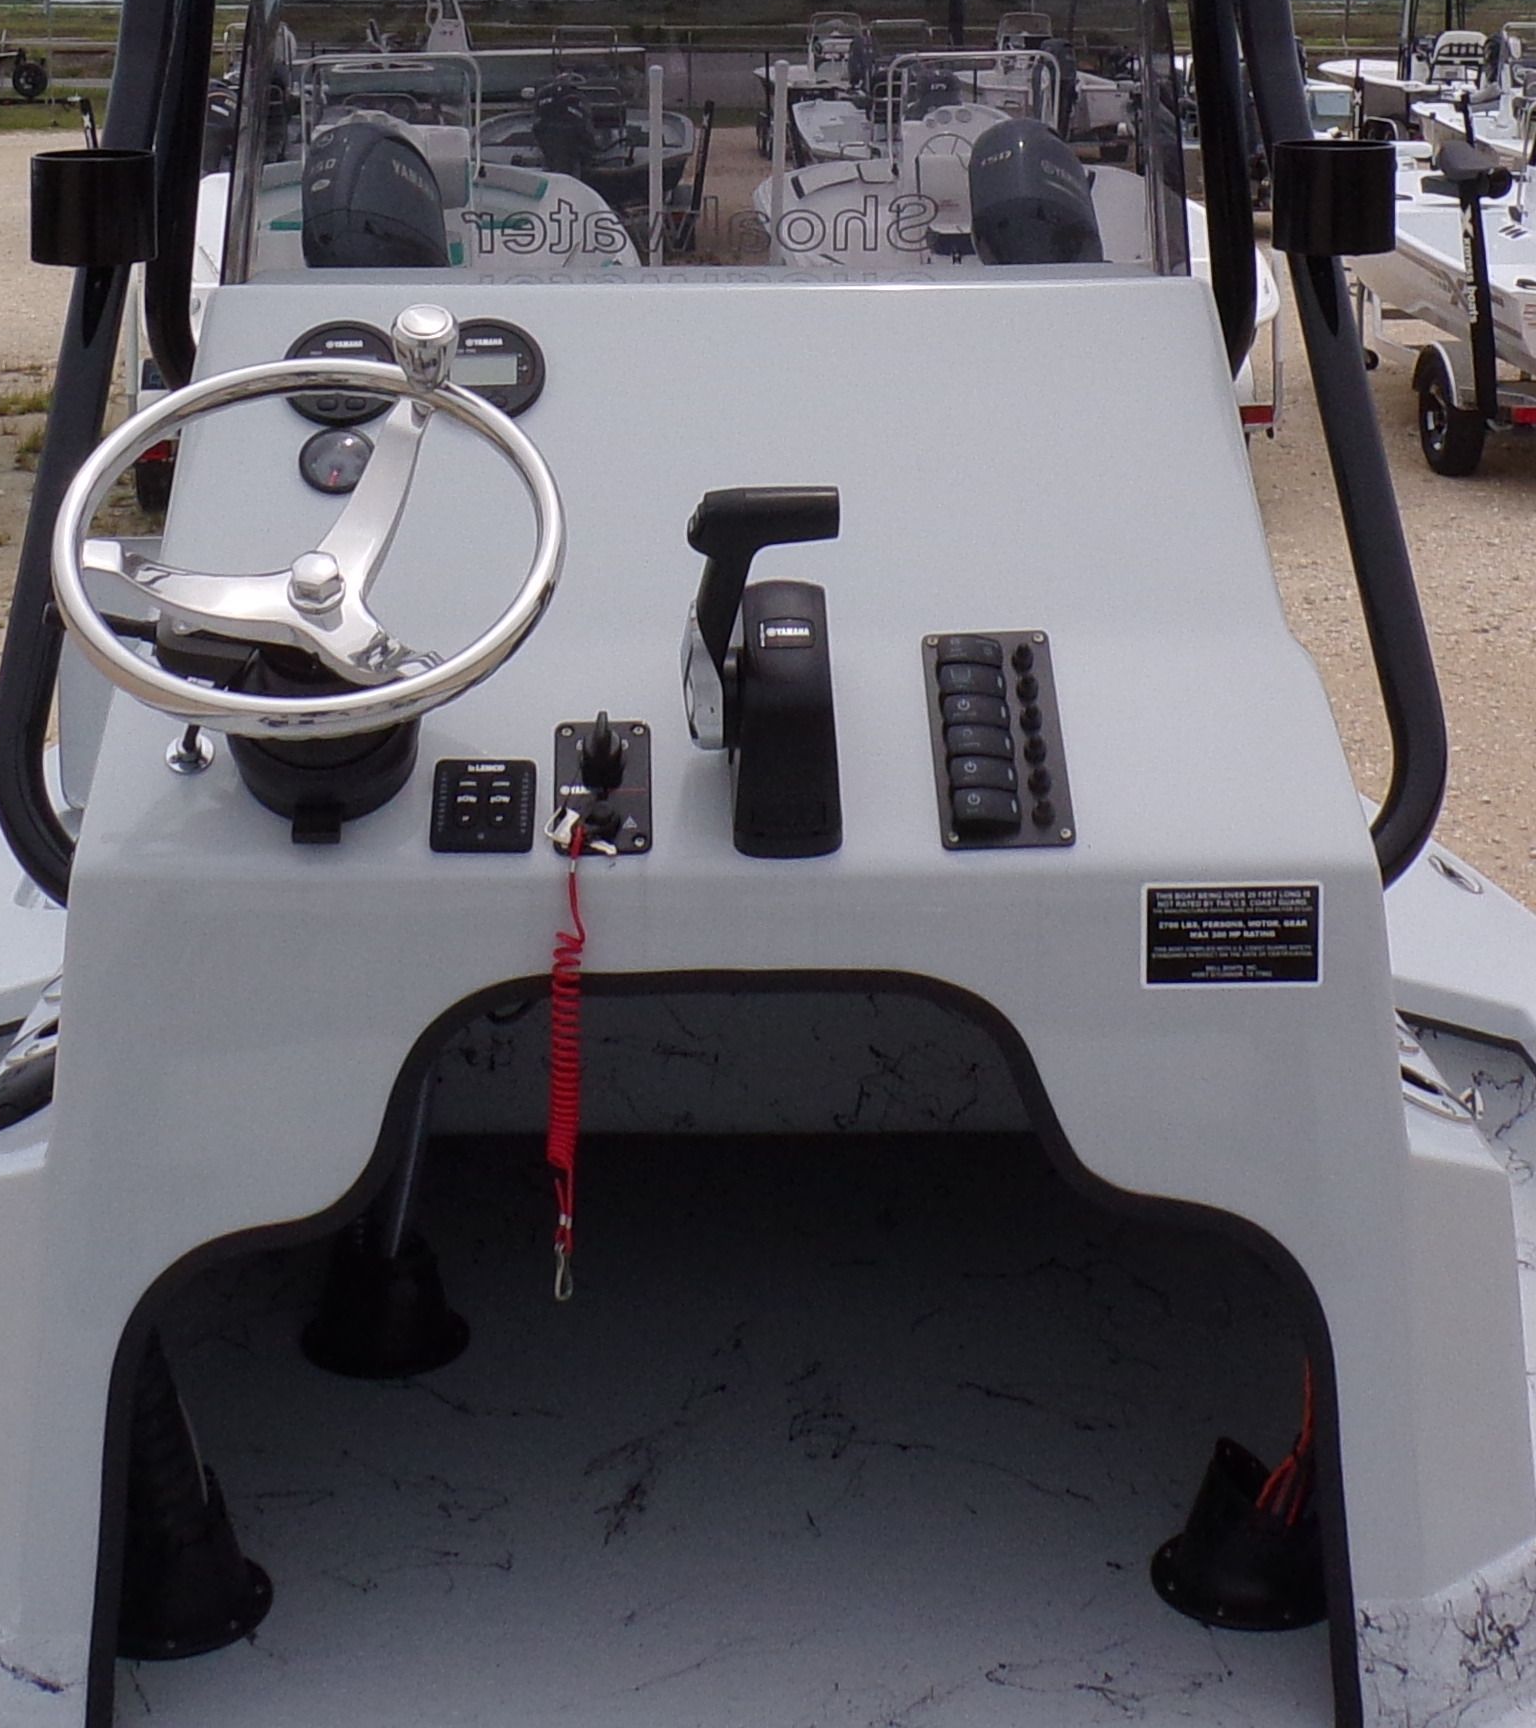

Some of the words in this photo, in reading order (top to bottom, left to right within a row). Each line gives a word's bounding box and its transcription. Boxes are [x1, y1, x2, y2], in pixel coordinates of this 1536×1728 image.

[334, 339, 364, 349] YAMAHA
[474, 338, 504, 347] YAMAHA
[776, 627, 810, 637] YAMAHA
[1175, 891, 1196, 900] BOAT
[1279, 890, 1302, 898] LONG
[1157, 900, 1173, 908] NOT
[1216, 899, 1231, 907] THE
[1249, 899, 1276, 907] COAST
